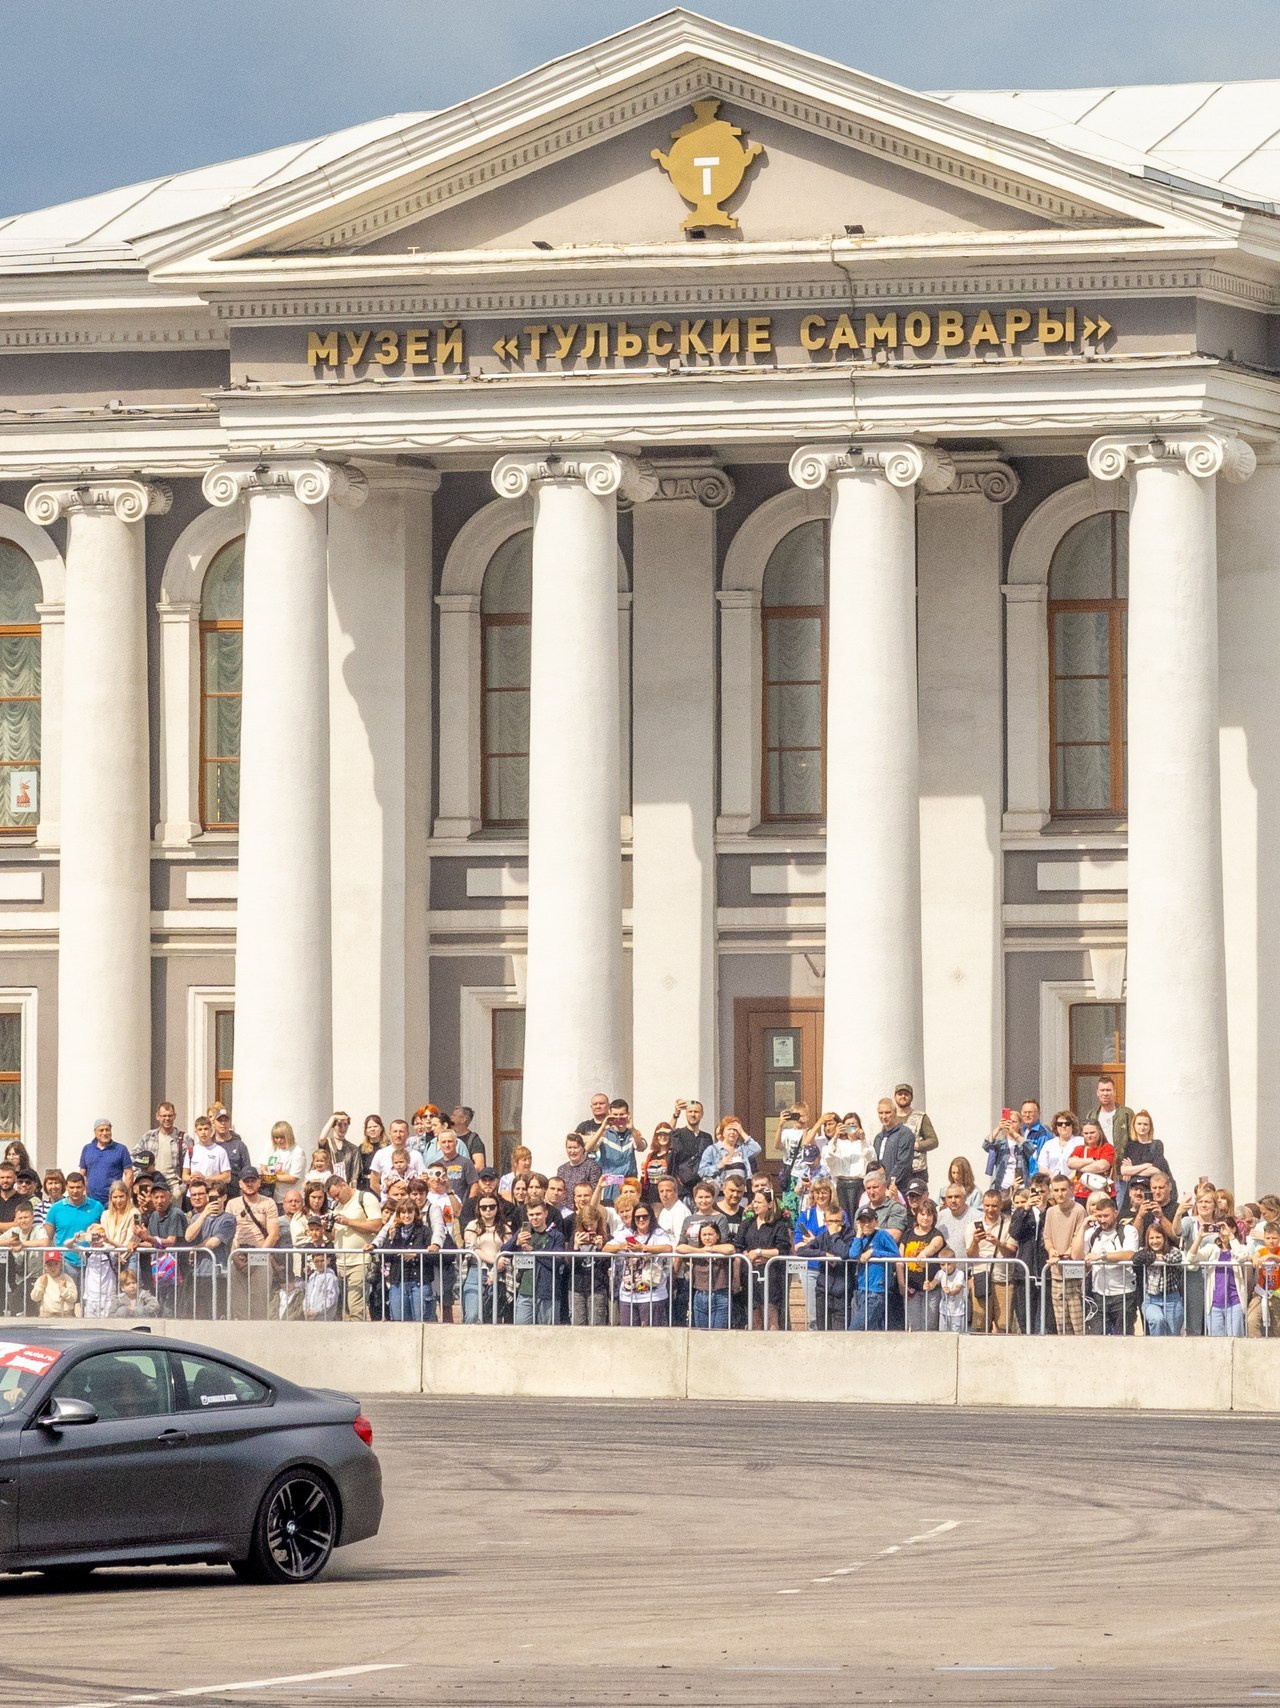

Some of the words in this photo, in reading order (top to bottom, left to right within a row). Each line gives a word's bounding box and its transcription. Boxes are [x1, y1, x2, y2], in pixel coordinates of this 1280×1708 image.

[307, 320, 463, 366] МУЗЕЙ
[492, 316, 772, 361] «ТУЛЬСКИЕ
[800, 306, 1112, 351] САМОВАРЫ»
